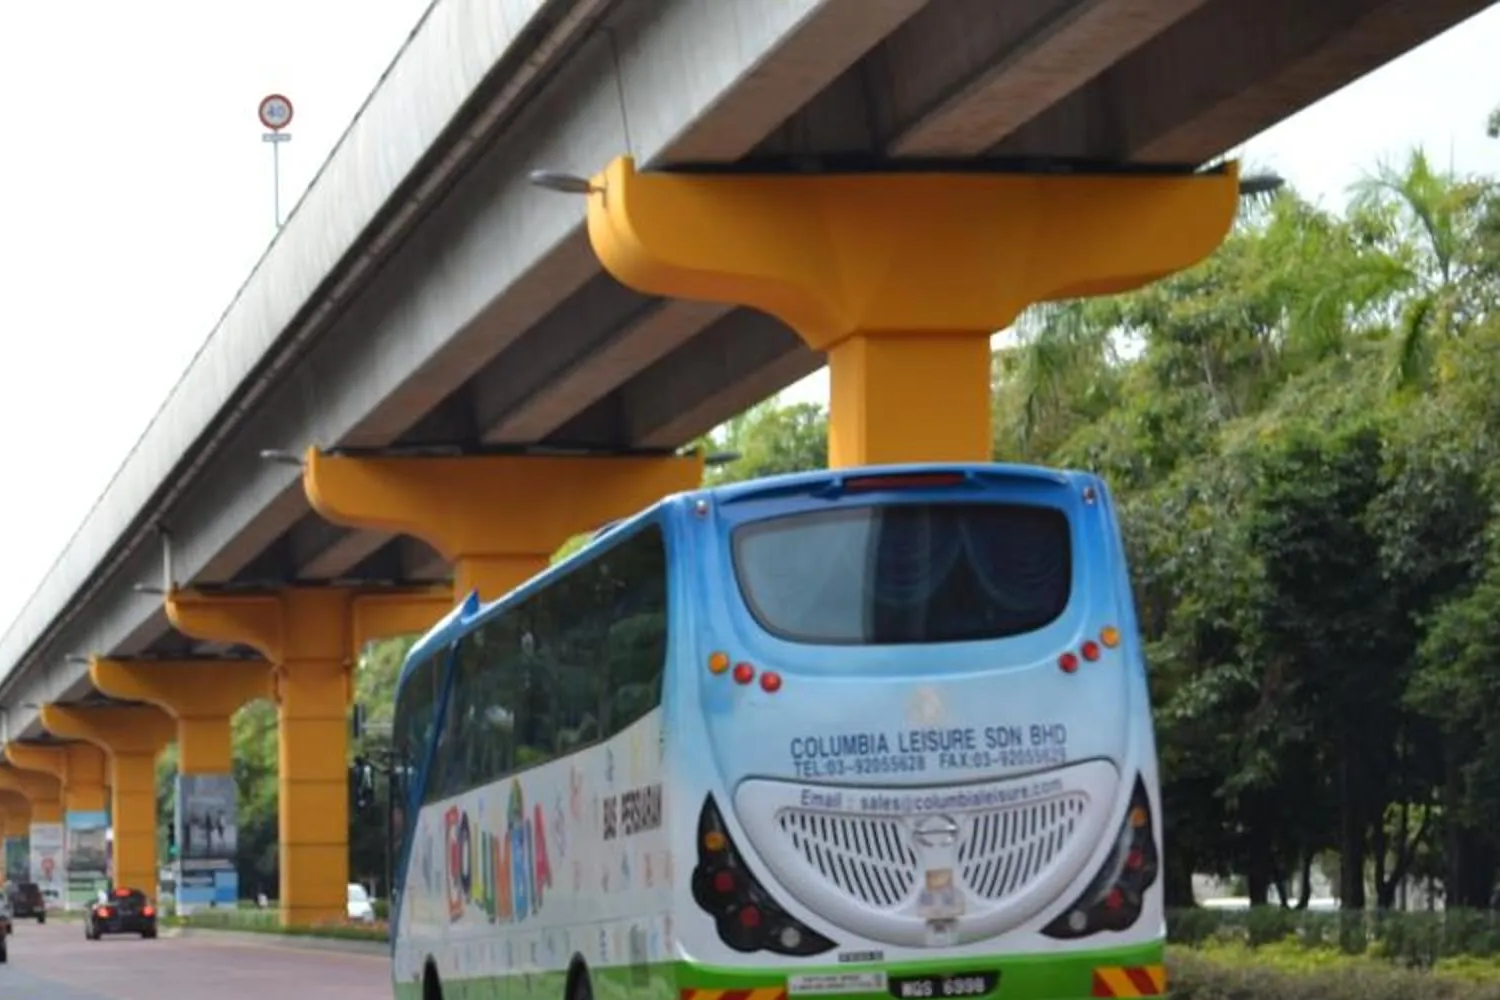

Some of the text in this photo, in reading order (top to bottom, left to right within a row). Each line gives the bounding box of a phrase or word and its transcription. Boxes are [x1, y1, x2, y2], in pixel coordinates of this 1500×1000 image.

[790, 723, 1067, 758] COLUMBIA LEISURE SDN BHD
[801, 788, 842, 807] Email
